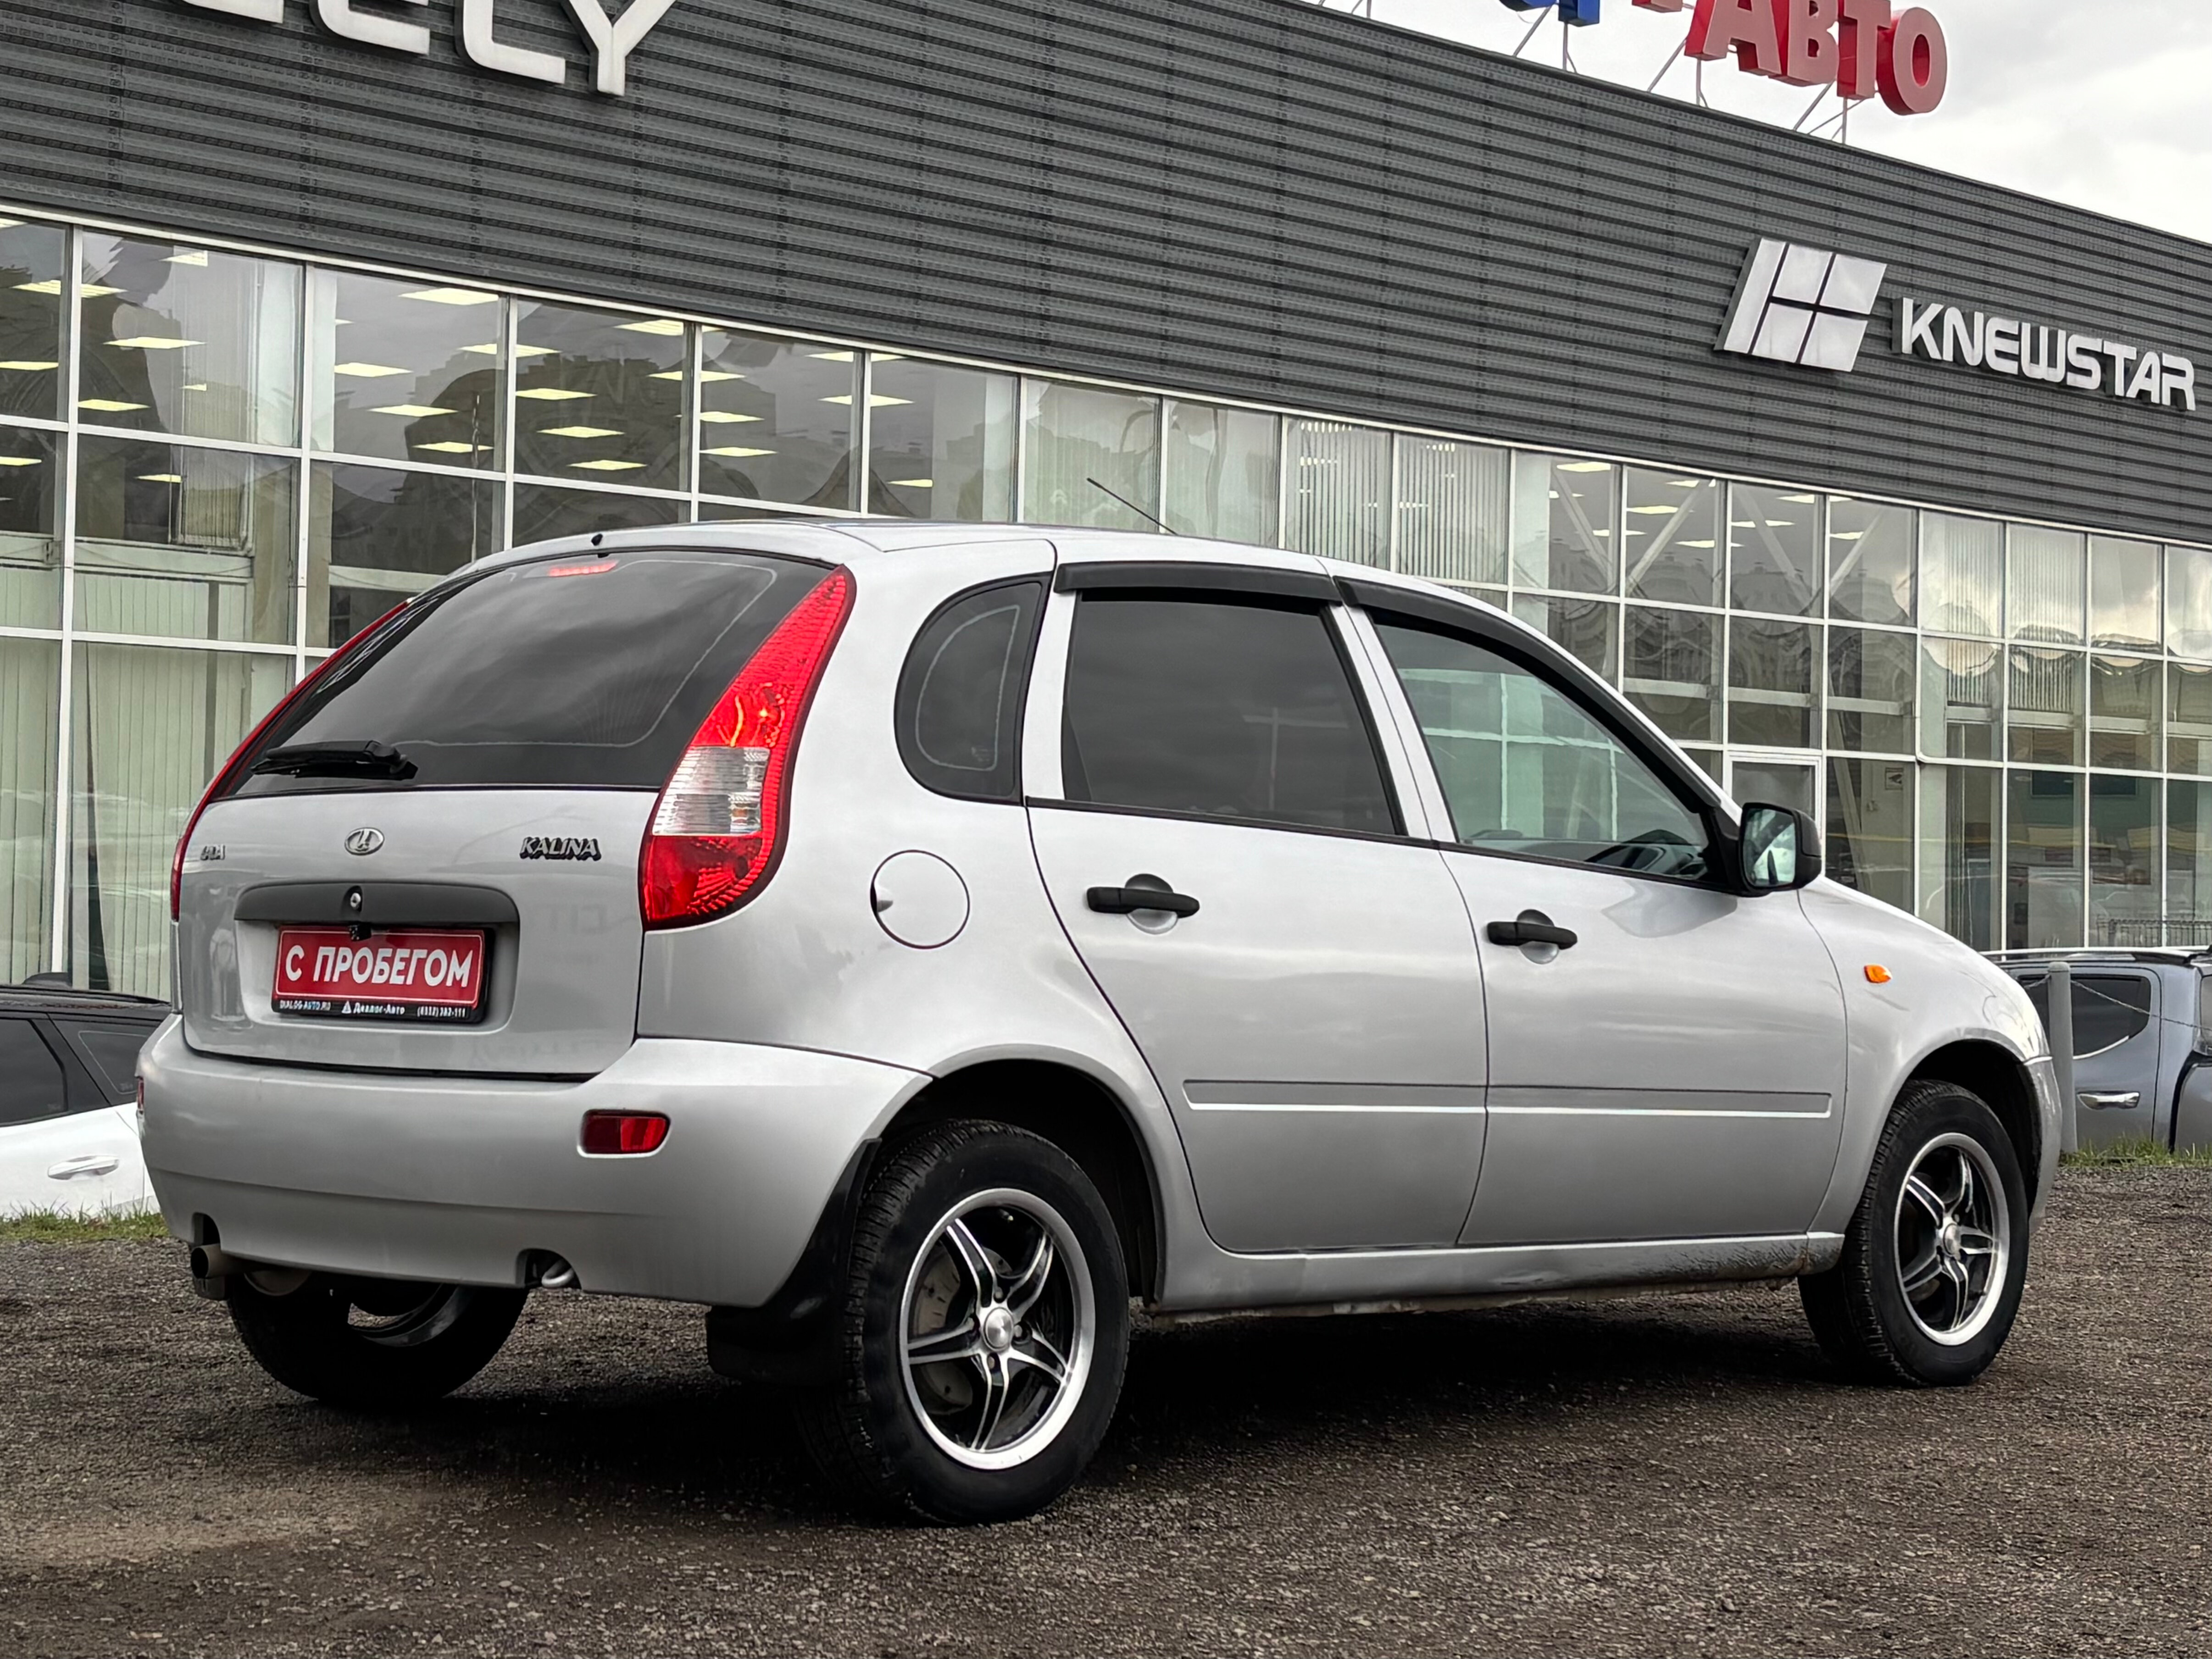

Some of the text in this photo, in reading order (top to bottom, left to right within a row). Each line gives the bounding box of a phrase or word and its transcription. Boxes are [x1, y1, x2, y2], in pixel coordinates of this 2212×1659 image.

[1899, 296, 2196, 411] KNEWSTAR
[519, 837, 602, 861] KALINA
[285, 945, 473, 988] С ПРОБЕГОМ
